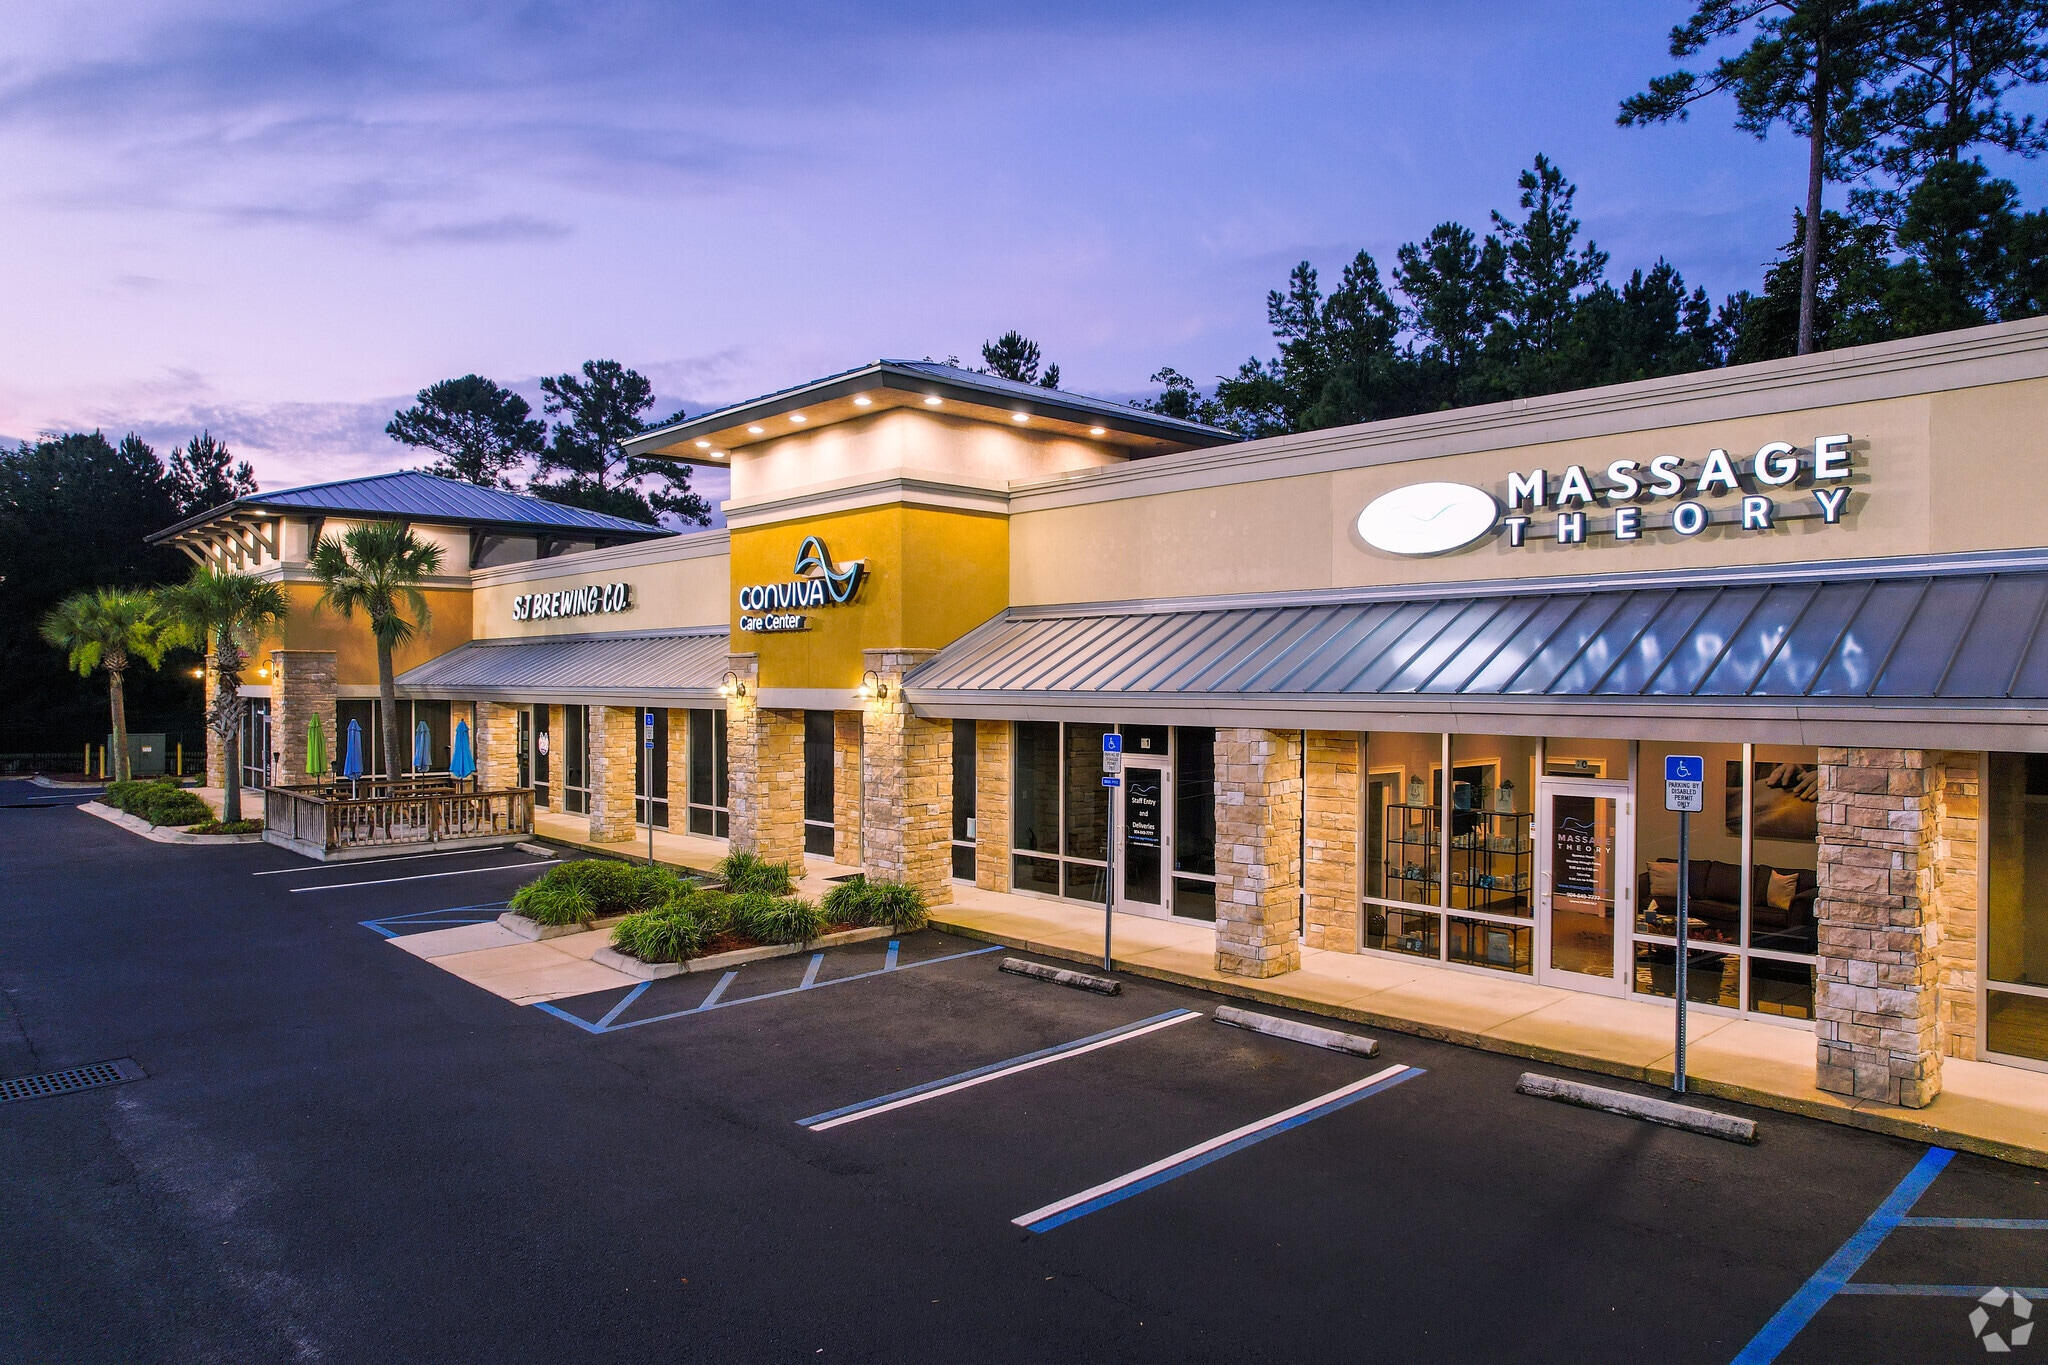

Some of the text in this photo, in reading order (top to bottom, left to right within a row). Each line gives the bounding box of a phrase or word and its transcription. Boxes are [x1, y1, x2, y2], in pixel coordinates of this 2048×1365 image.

[1507, 434, 1852, 509] MASSAGE
[1505, 487, 1852, 547] THEORY
[512, 582, 627, 621] SJ BREWING CO.
[740, 613, 800, 631] Care Center
[1143, 798, 1157, 806] Entry
[1677, 800, 1691, 808] ONLY
[1132, 821, 1155, 830] Deliveries
[1557, 842, 1611, 854] THEORY
